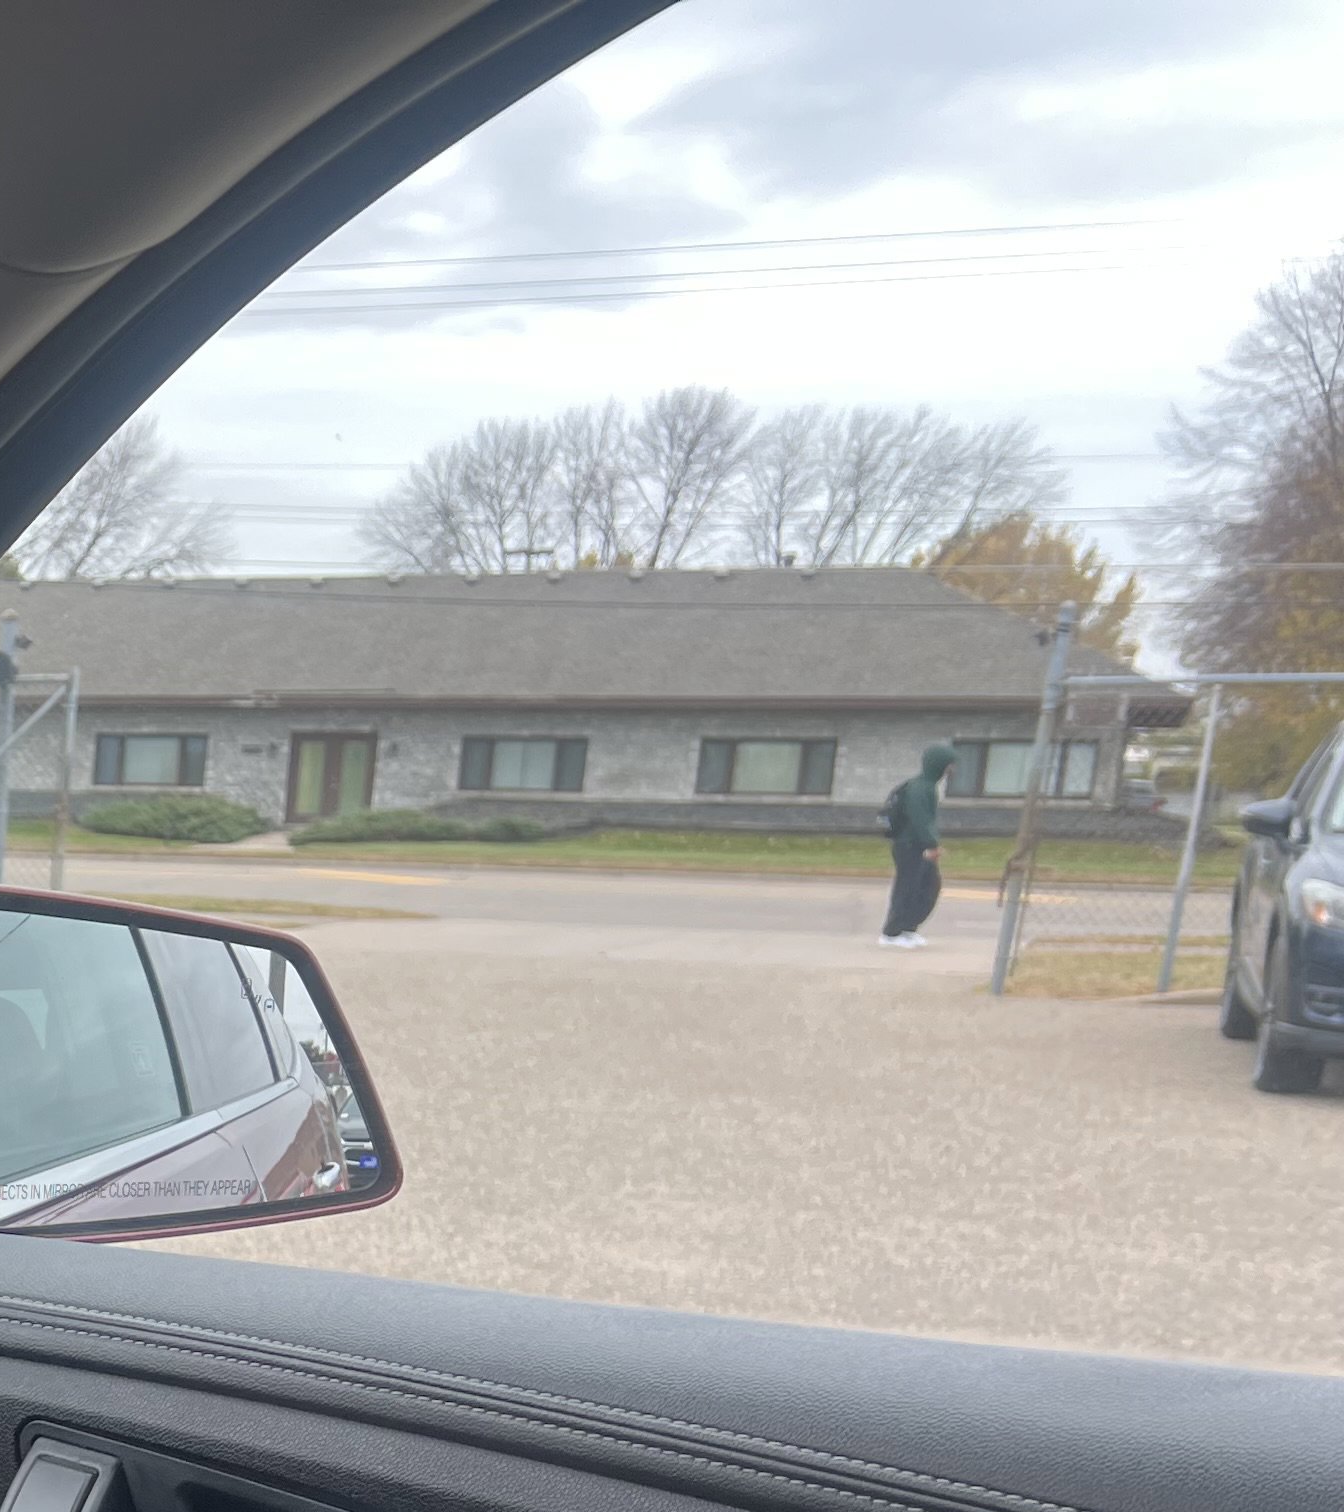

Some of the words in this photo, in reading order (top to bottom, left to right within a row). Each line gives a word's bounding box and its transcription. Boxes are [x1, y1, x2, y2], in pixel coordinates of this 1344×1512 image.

[30, 1183, 42, 1200] IN
[109, 1182, 151, 1199] CLOSER
[153, 1181, 182, 1198] THAN
[183, 1180, 210, 1197] THEY
[211, 1179, 251, 1196] APPEAR
